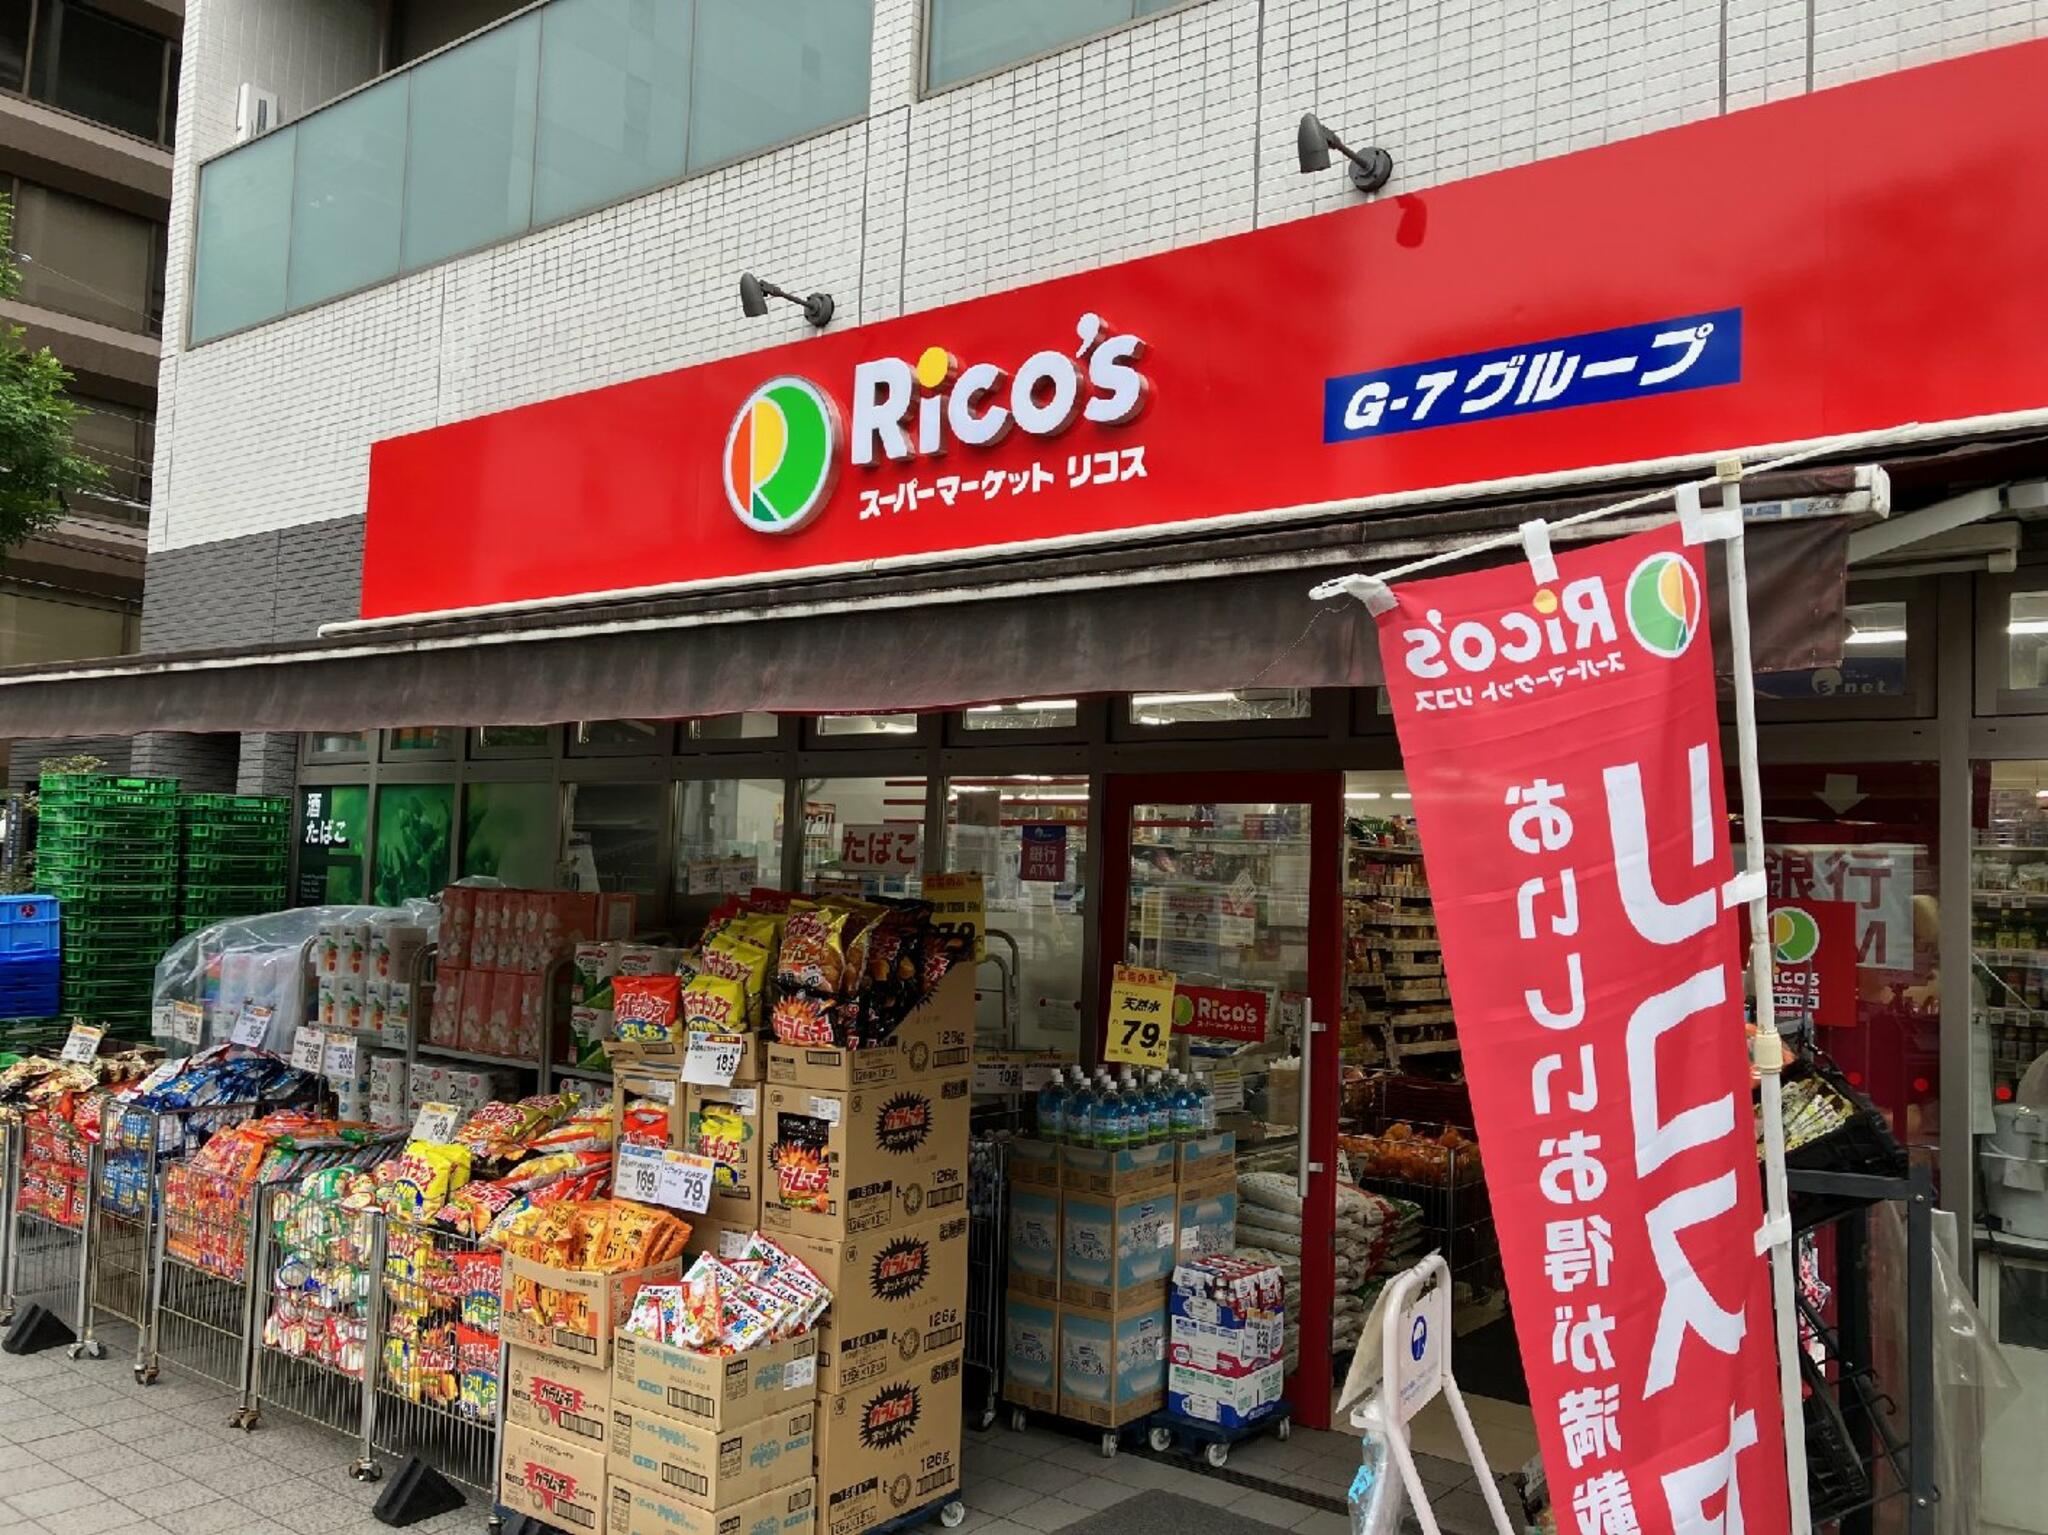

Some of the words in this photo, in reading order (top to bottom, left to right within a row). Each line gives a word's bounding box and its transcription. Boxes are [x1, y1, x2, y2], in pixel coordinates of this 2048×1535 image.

[859, 464, 1054, 519] スーパーマーケット
[1067, 446, 1147, 488] リコス
[307, 793, 322, 817] 酒
[305, 820, 347, 845] たばこ
[843, 831, 917, 865] たばこ
[1121, 996, 1162, 1014] 天然水
[1121, 1020, 1160, 1049] 79
[920, 1450, 950, 1472] 126g
